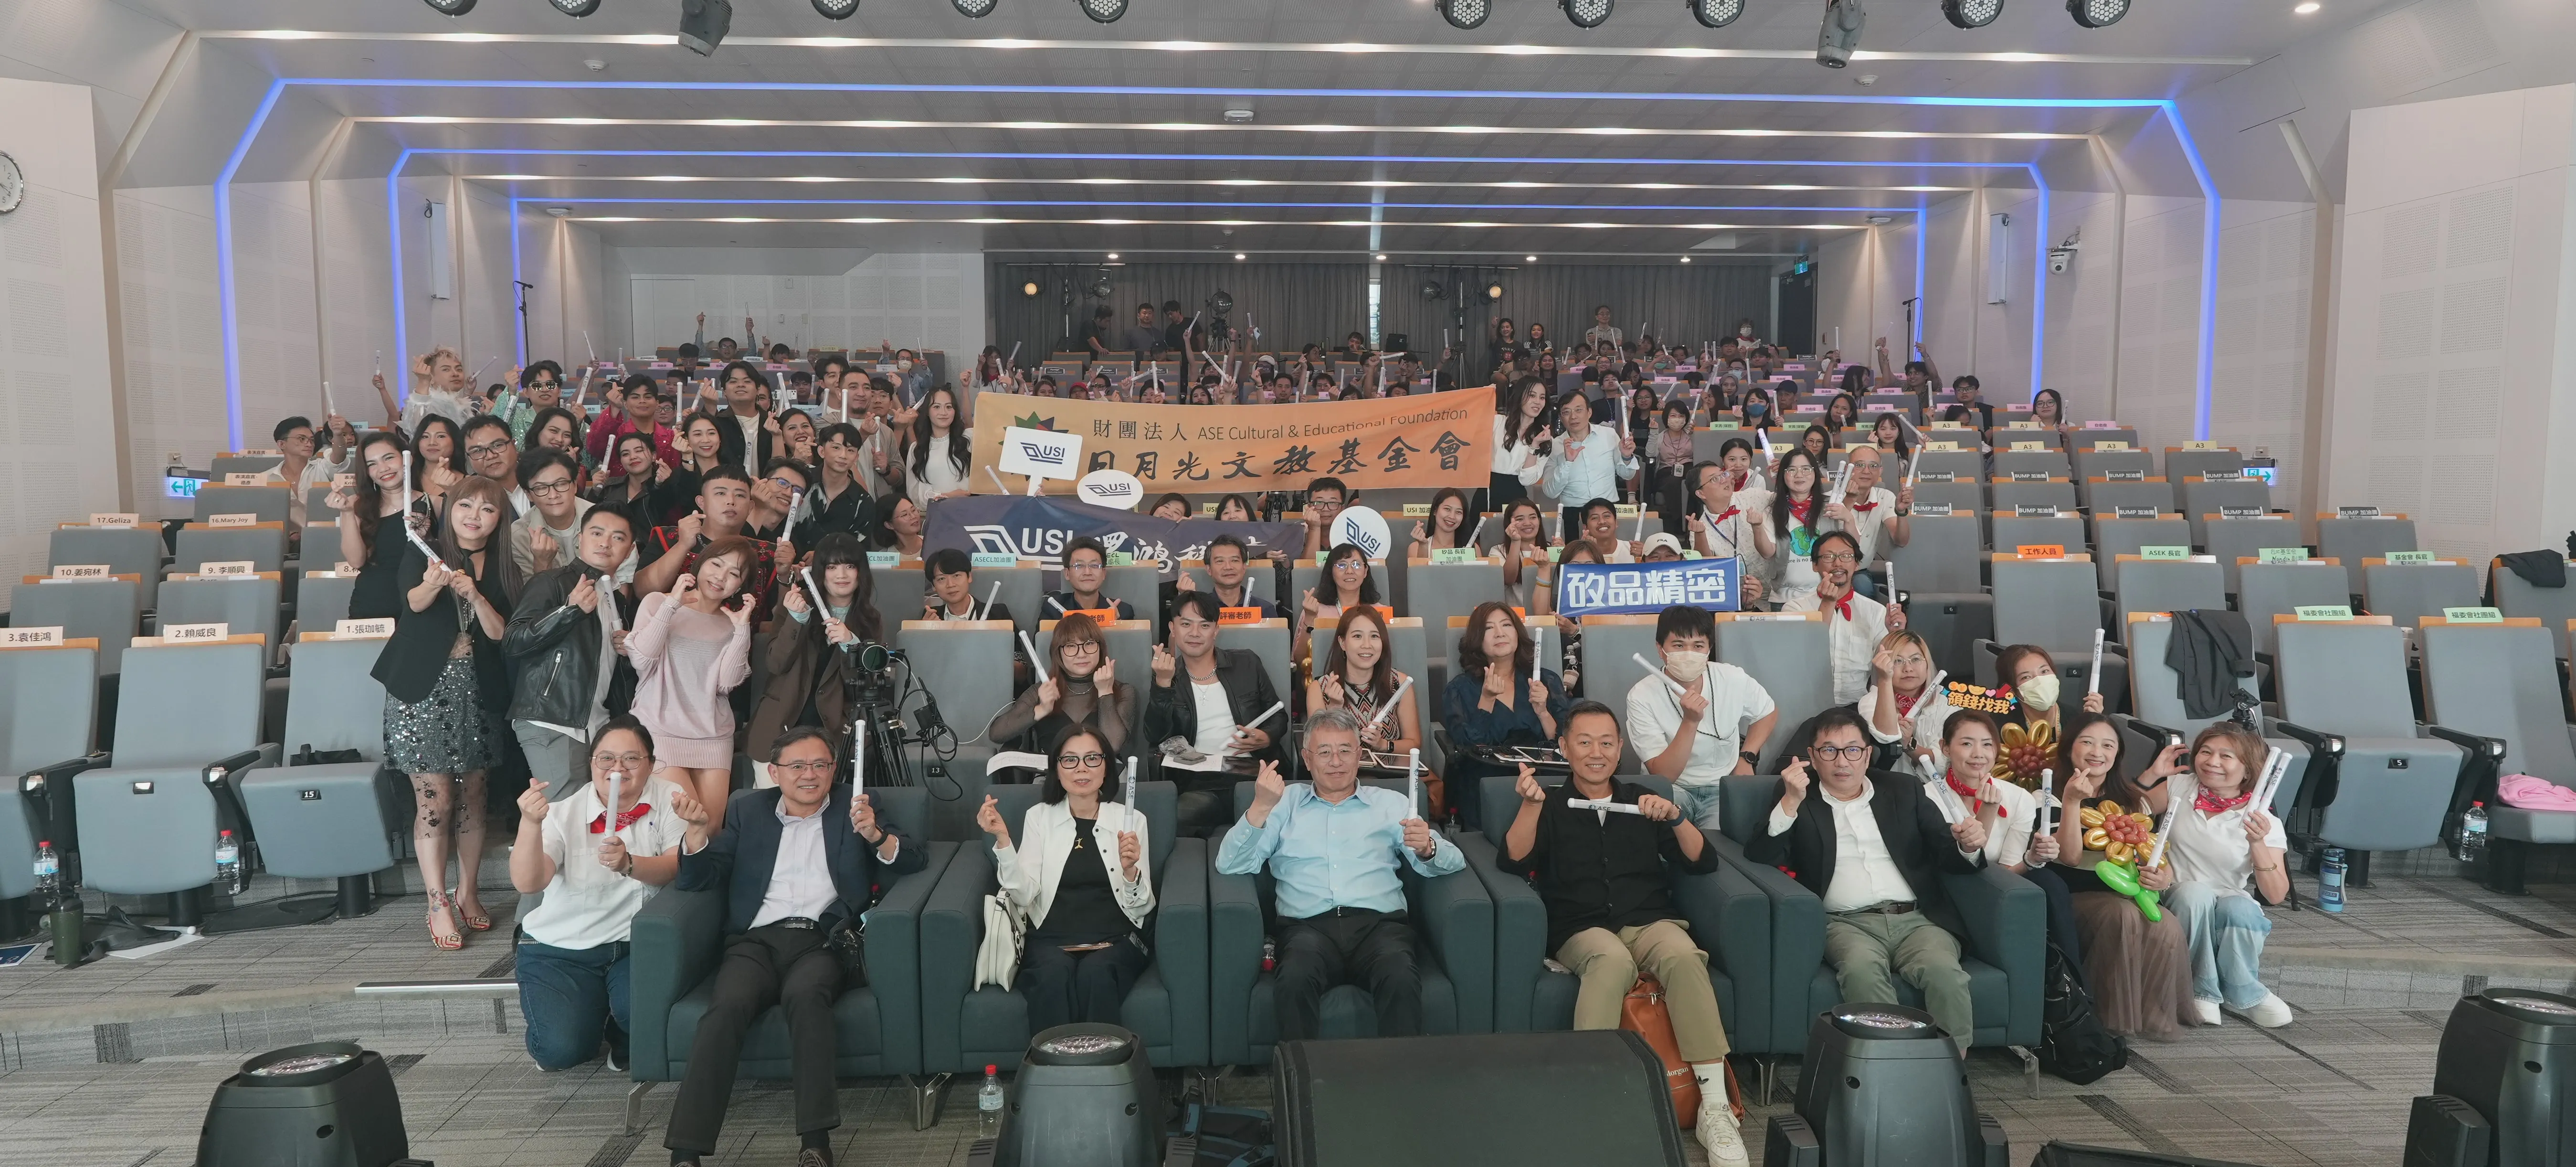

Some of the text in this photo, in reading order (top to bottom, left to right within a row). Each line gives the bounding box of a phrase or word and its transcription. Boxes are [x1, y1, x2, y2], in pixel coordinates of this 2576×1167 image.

[1093, 408, 1468, 441] 財團法人 ASE Cultural & Educational Foundation
[1044, 445, 1066, 458] USI
[1088, 430, 1471, 481] 日月光文教基金會
[1109, 482, 1131, 492] USI
[1021, 527, 1074, 555] USI
[1361, 530, 1381, 552] USI
[61, 568, 102, 576] 10.姜宛林
[219, 566, 245, 574] 李順興
[1567, 568, 1726, 608] 矽品精密
[1220, 611, 1252, 620] 評審老師
[2451, 611, 2496, 619] 福委會社團組
[8, 631, 52, 644] 3.袁佳鴻
[175, 626, 217, 639] 2.賴威良
[1947, 691, 2010, 714] 領錢找我
[2270, 774, 2279, 786] ASE
[303, 791, 315, 799] 15
[2160, 819, 2170, 832] ASE
